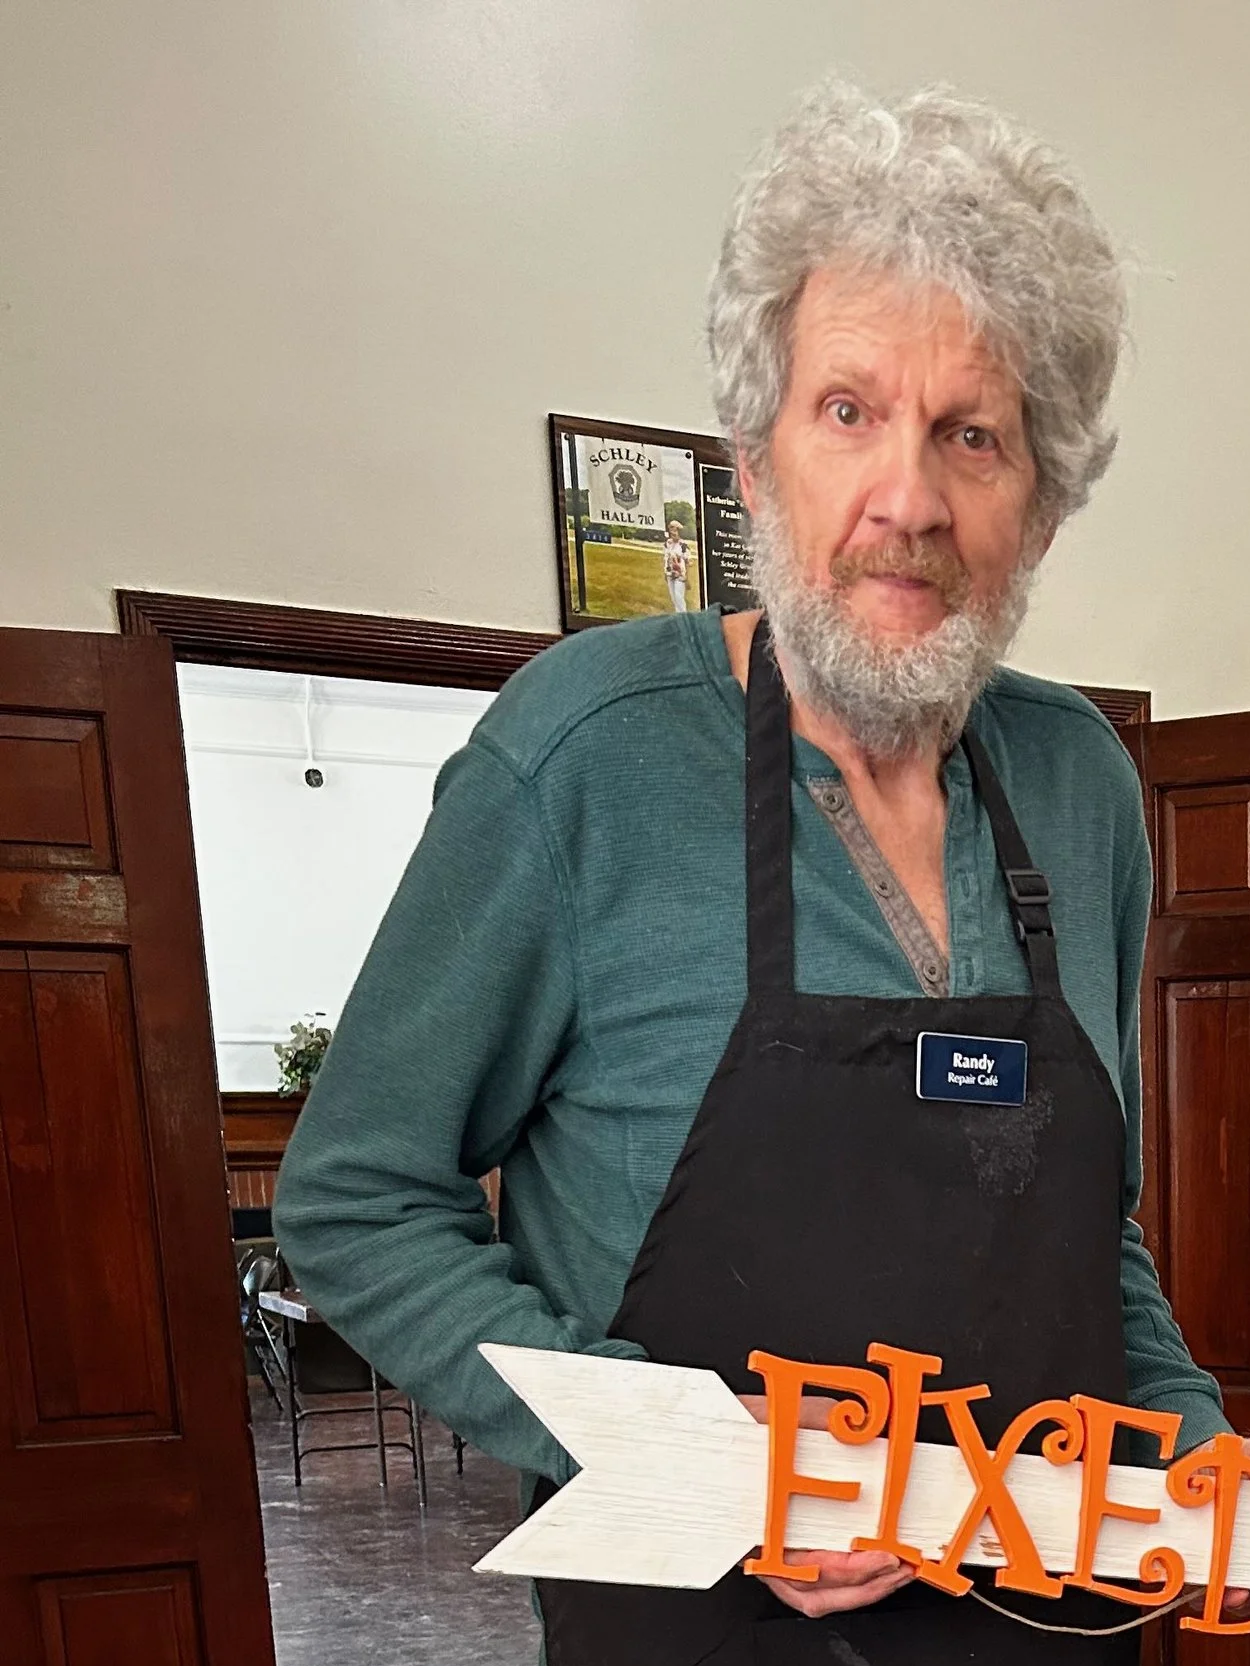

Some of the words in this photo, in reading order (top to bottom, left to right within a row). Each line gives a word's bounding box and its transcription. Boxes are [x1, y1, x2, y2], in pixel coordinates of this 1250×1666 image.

[589, 447, 657, 474] SCHLEY
[601, 509, 635, 524] HALL
[637, 514, 655, 526] 710
[720, 509, 743, 520] Famil
[953, 1052, 996, 1073] Randy
[947, 1072, 976, 1086] Repair
[977, 1074, 999, 1087] Café
